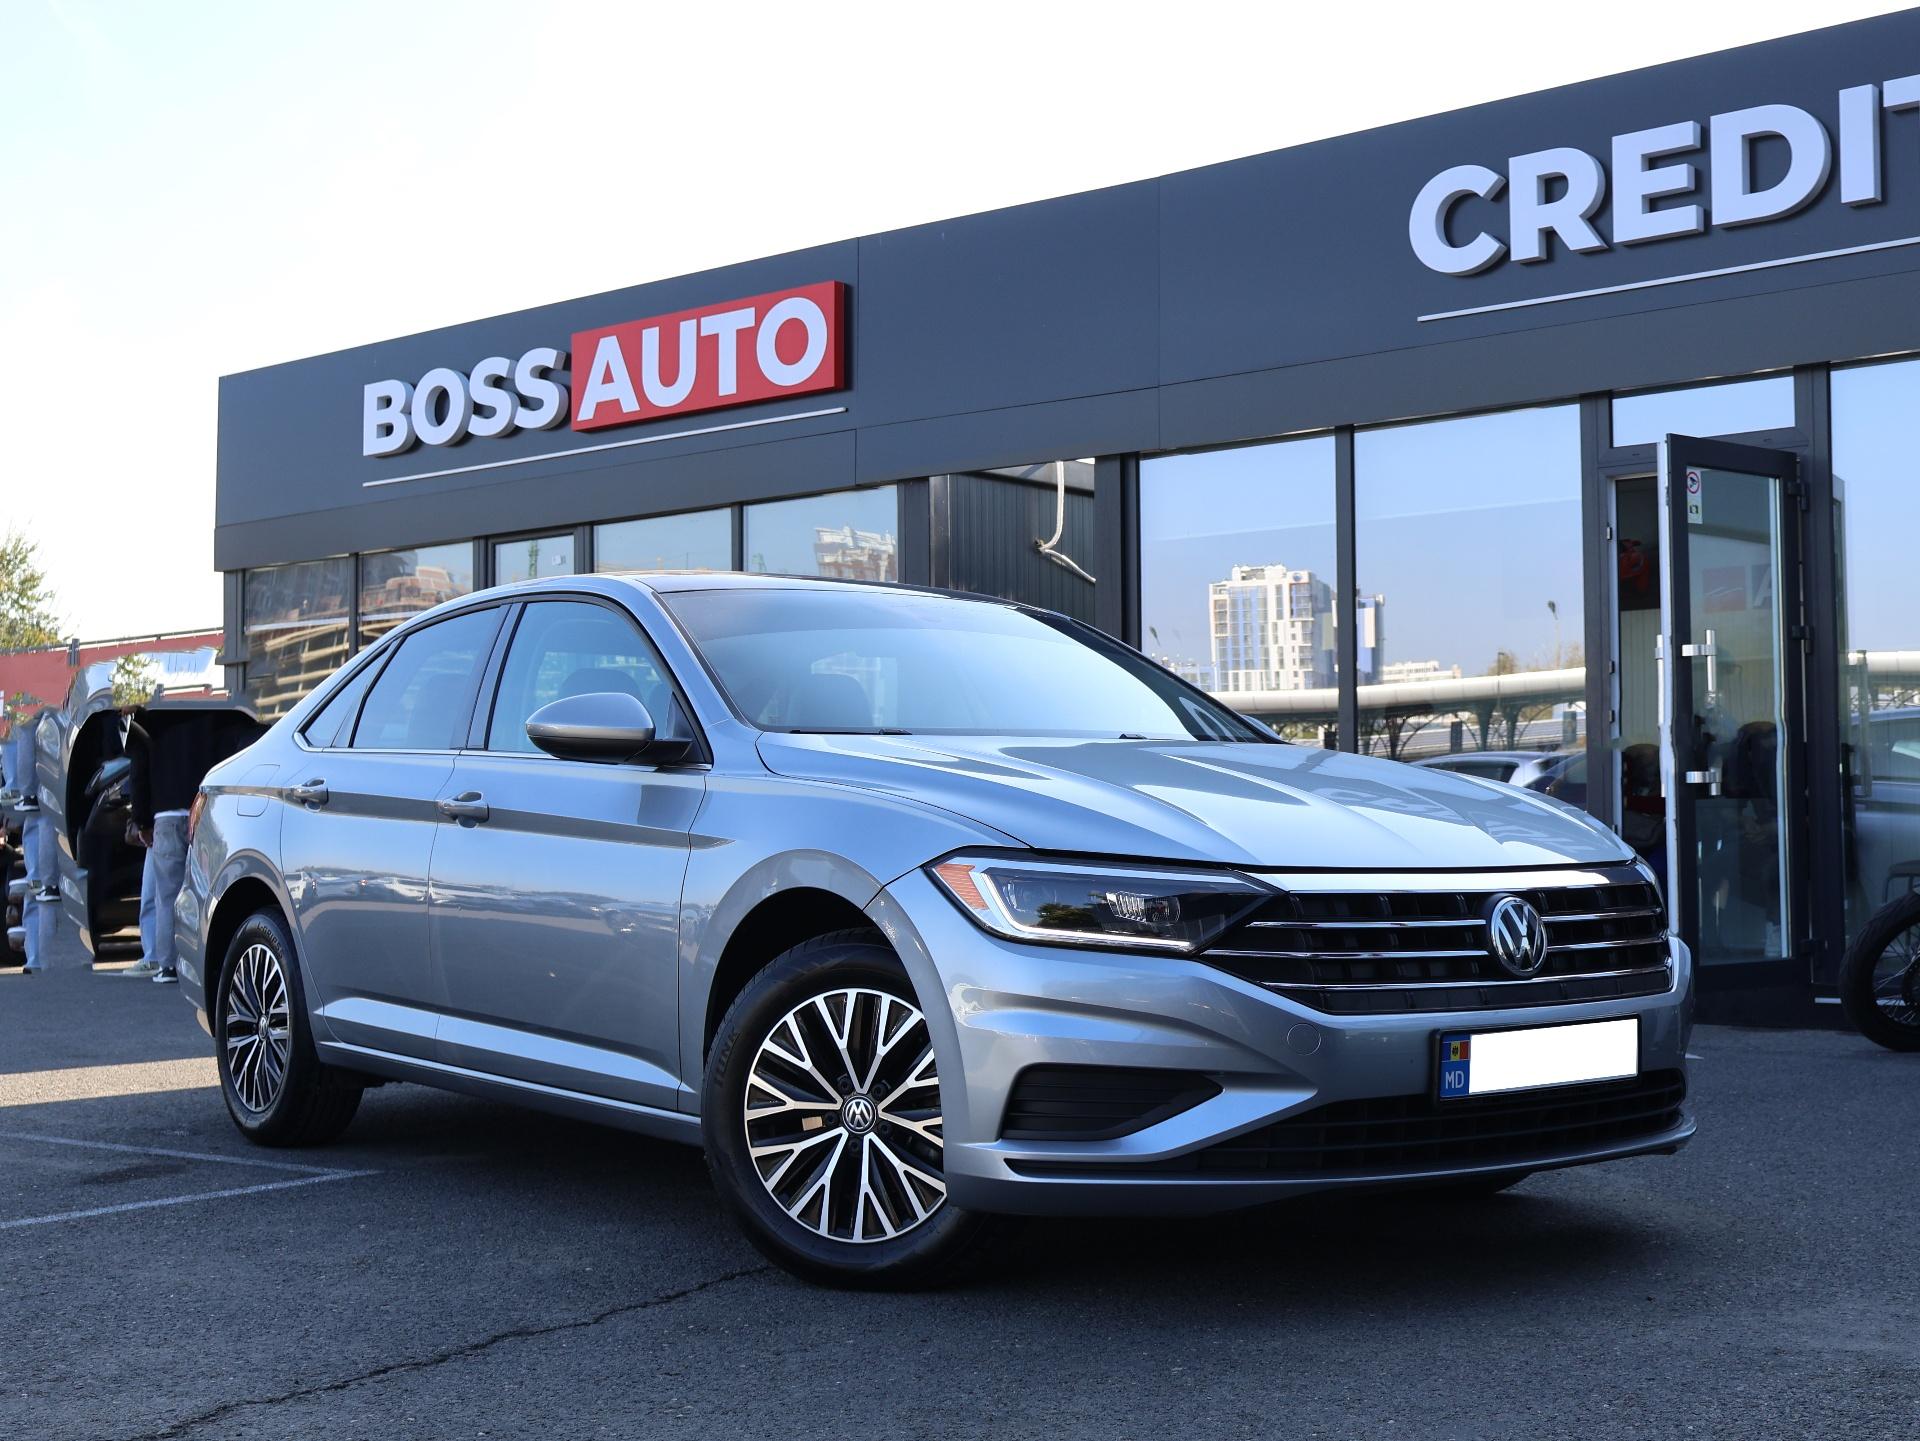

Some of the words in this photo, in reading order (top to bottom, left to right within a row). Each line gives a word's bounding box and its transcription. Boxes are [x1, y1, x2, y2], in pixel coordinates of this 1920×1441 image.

[363, 347, 569, 457] BOSS
[576, 296, 828, 421] AUTO
[1445, 1070, 1465, 1089] MD
